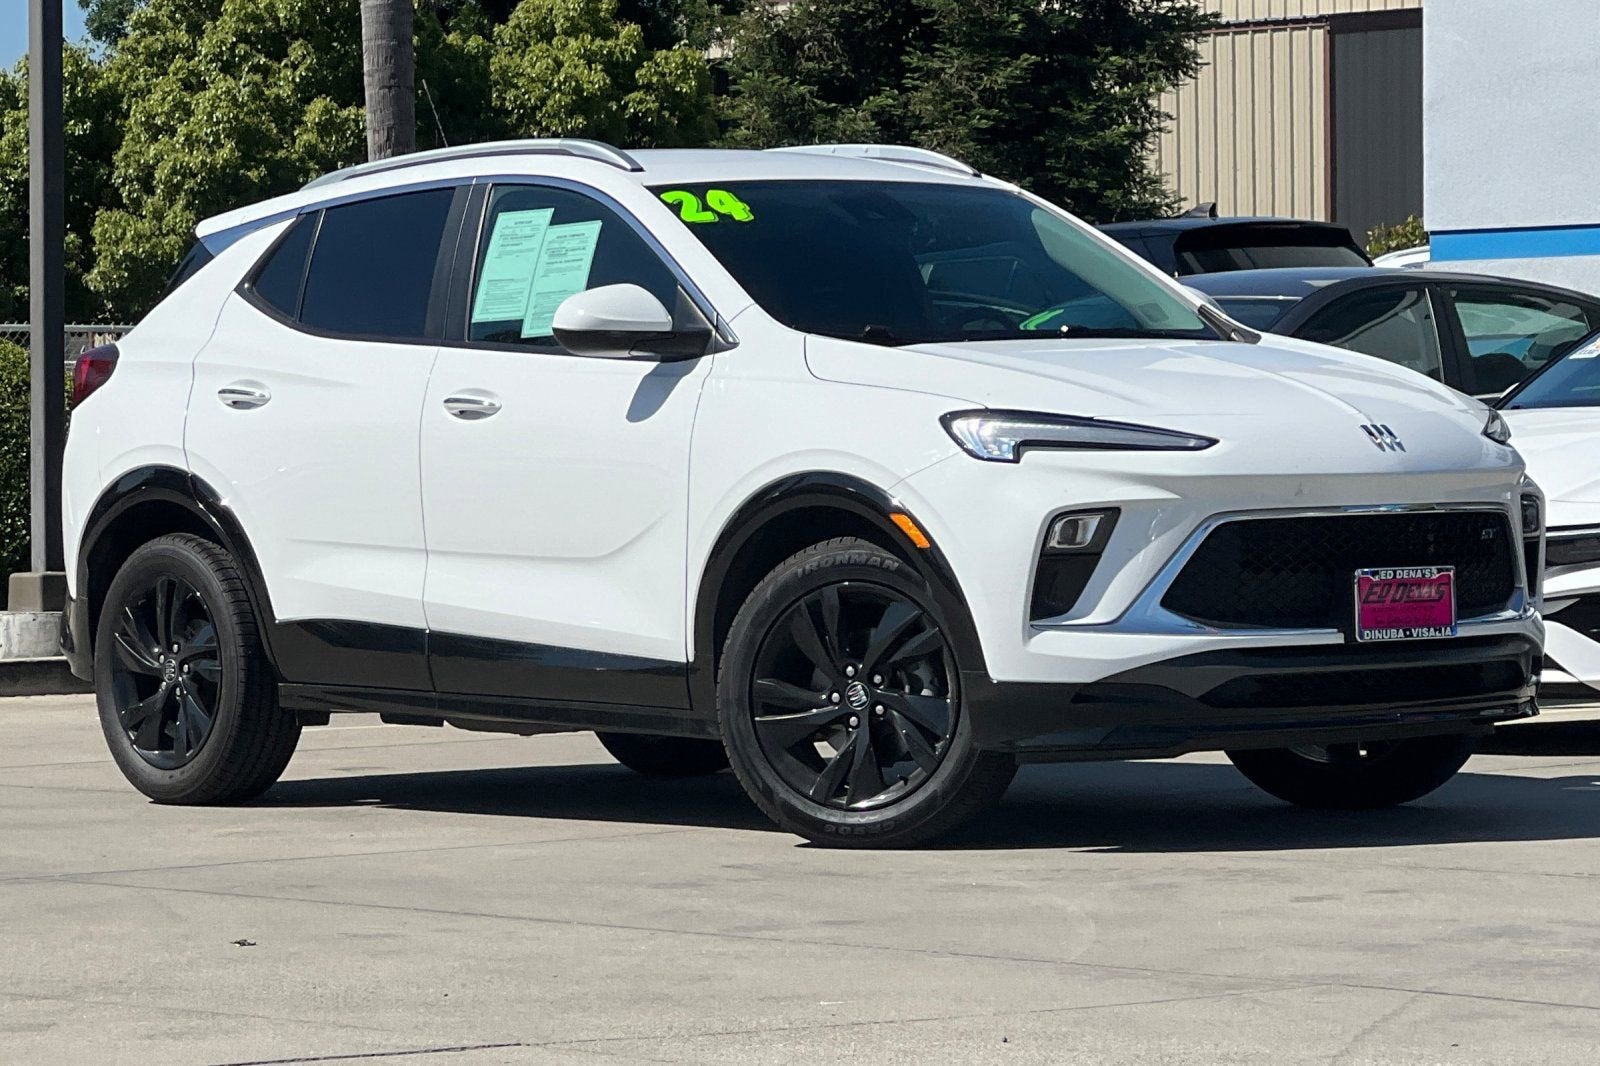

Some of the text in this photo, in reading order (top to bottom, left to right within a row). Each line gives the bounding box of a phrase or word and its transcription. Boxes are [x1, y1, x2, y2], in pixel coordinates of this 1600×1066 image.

[660, 189, 754, 223] 24
[797, 551, 900, 578] IRONMAN
[1380, 568, 1431, 579] ED DENA'S
[1364, 629, 1405, 640] DINUBA
